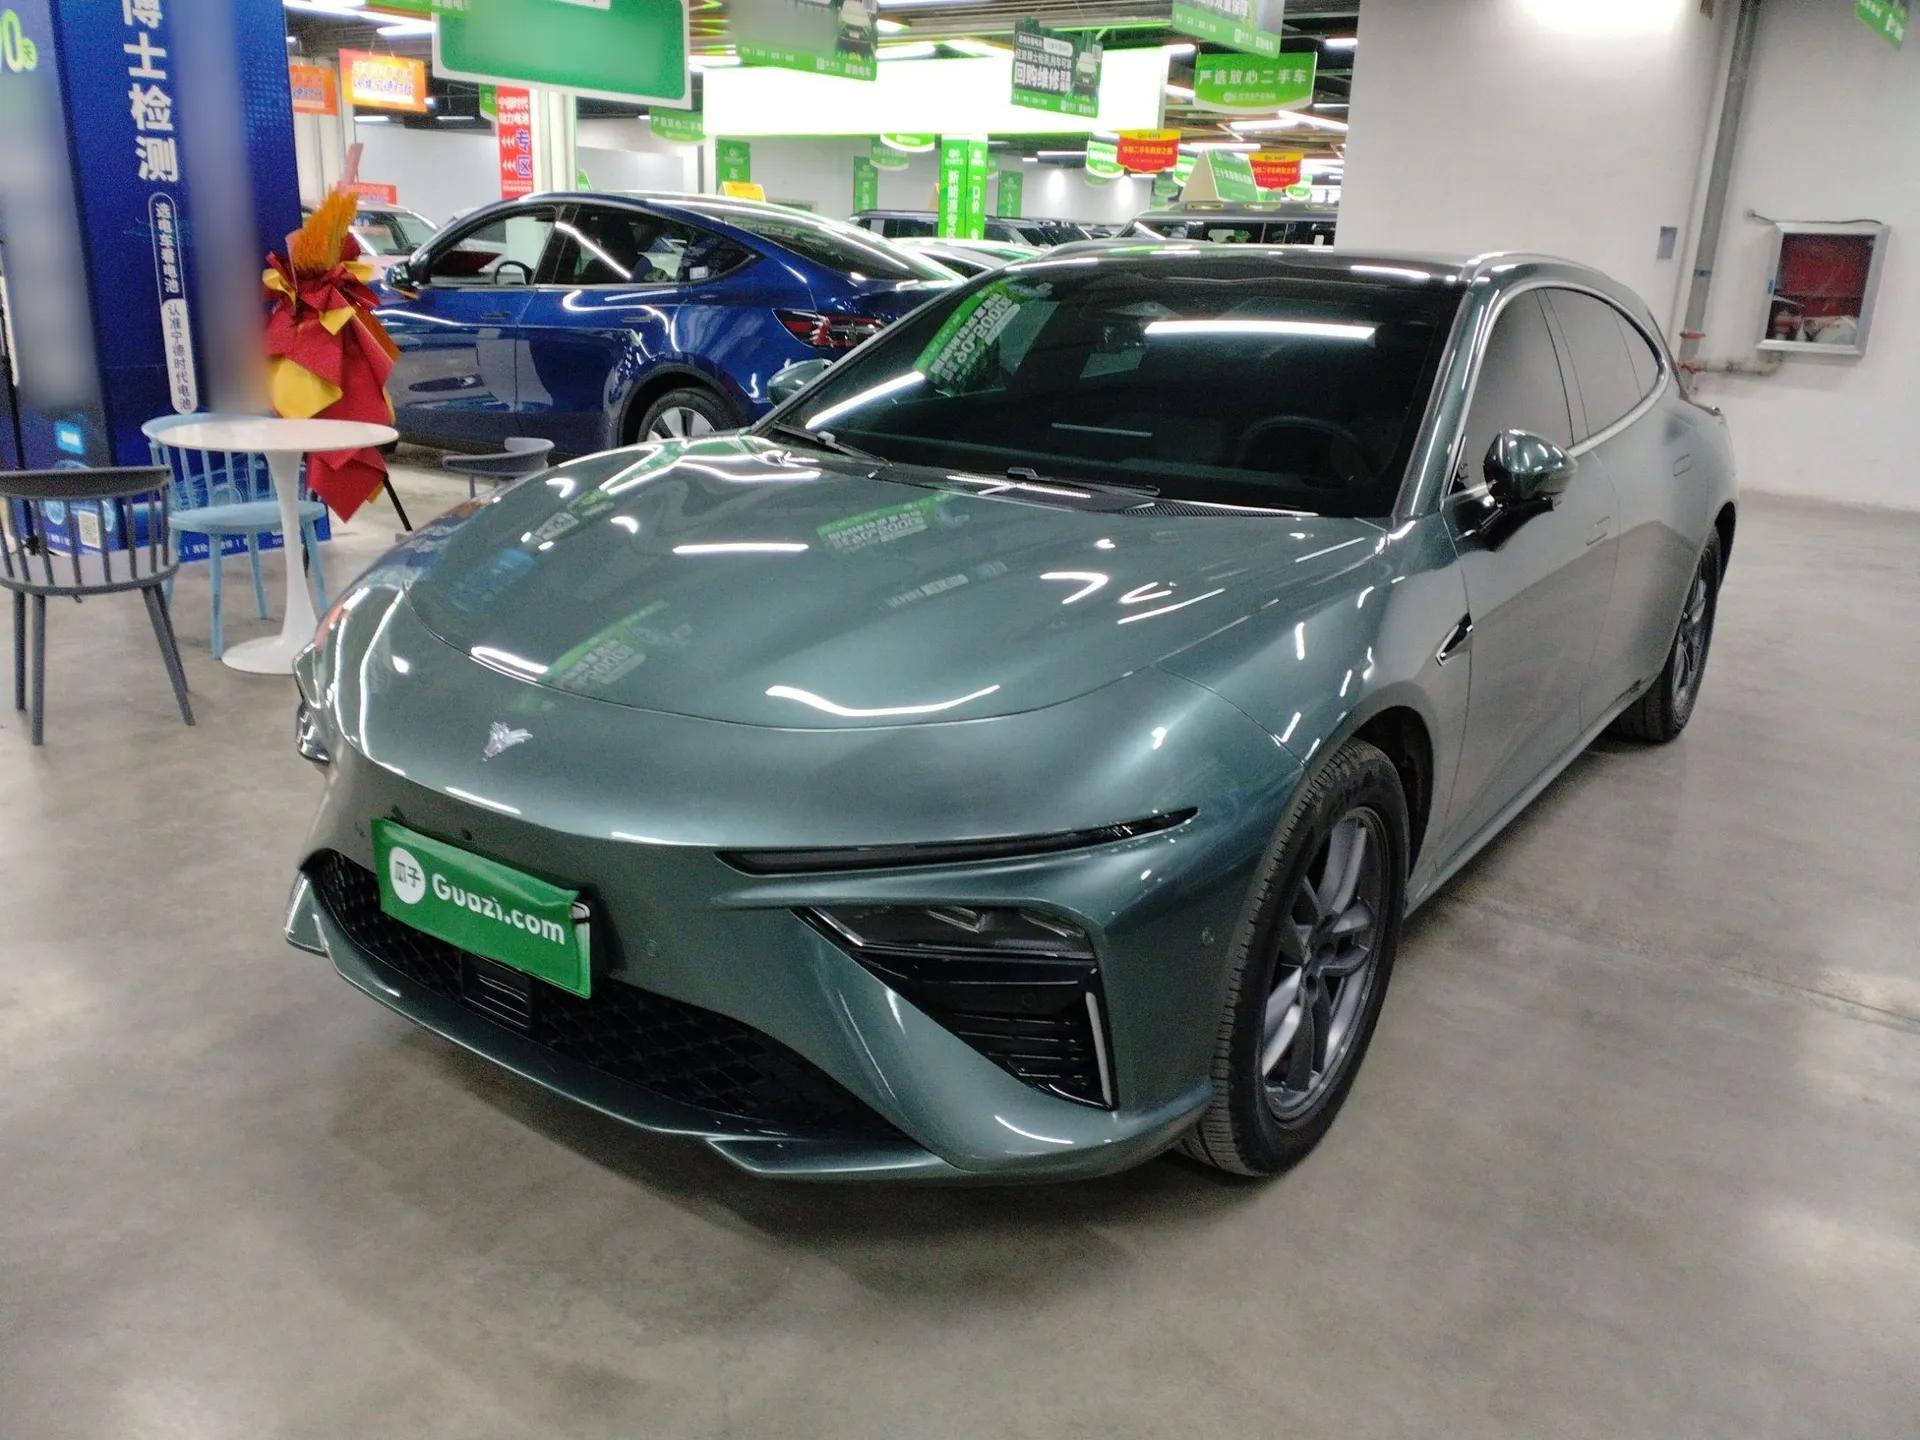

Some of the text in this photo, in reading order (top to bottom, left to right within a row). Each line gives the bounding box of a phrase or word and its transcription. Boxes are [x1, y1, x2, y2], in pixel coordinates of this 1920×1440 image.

[122, 0, 178, 183] 博士检测
[1199, 69, 1307, 86] 严选放心二手车
[432, 873, 566, 946] Guazi.com
